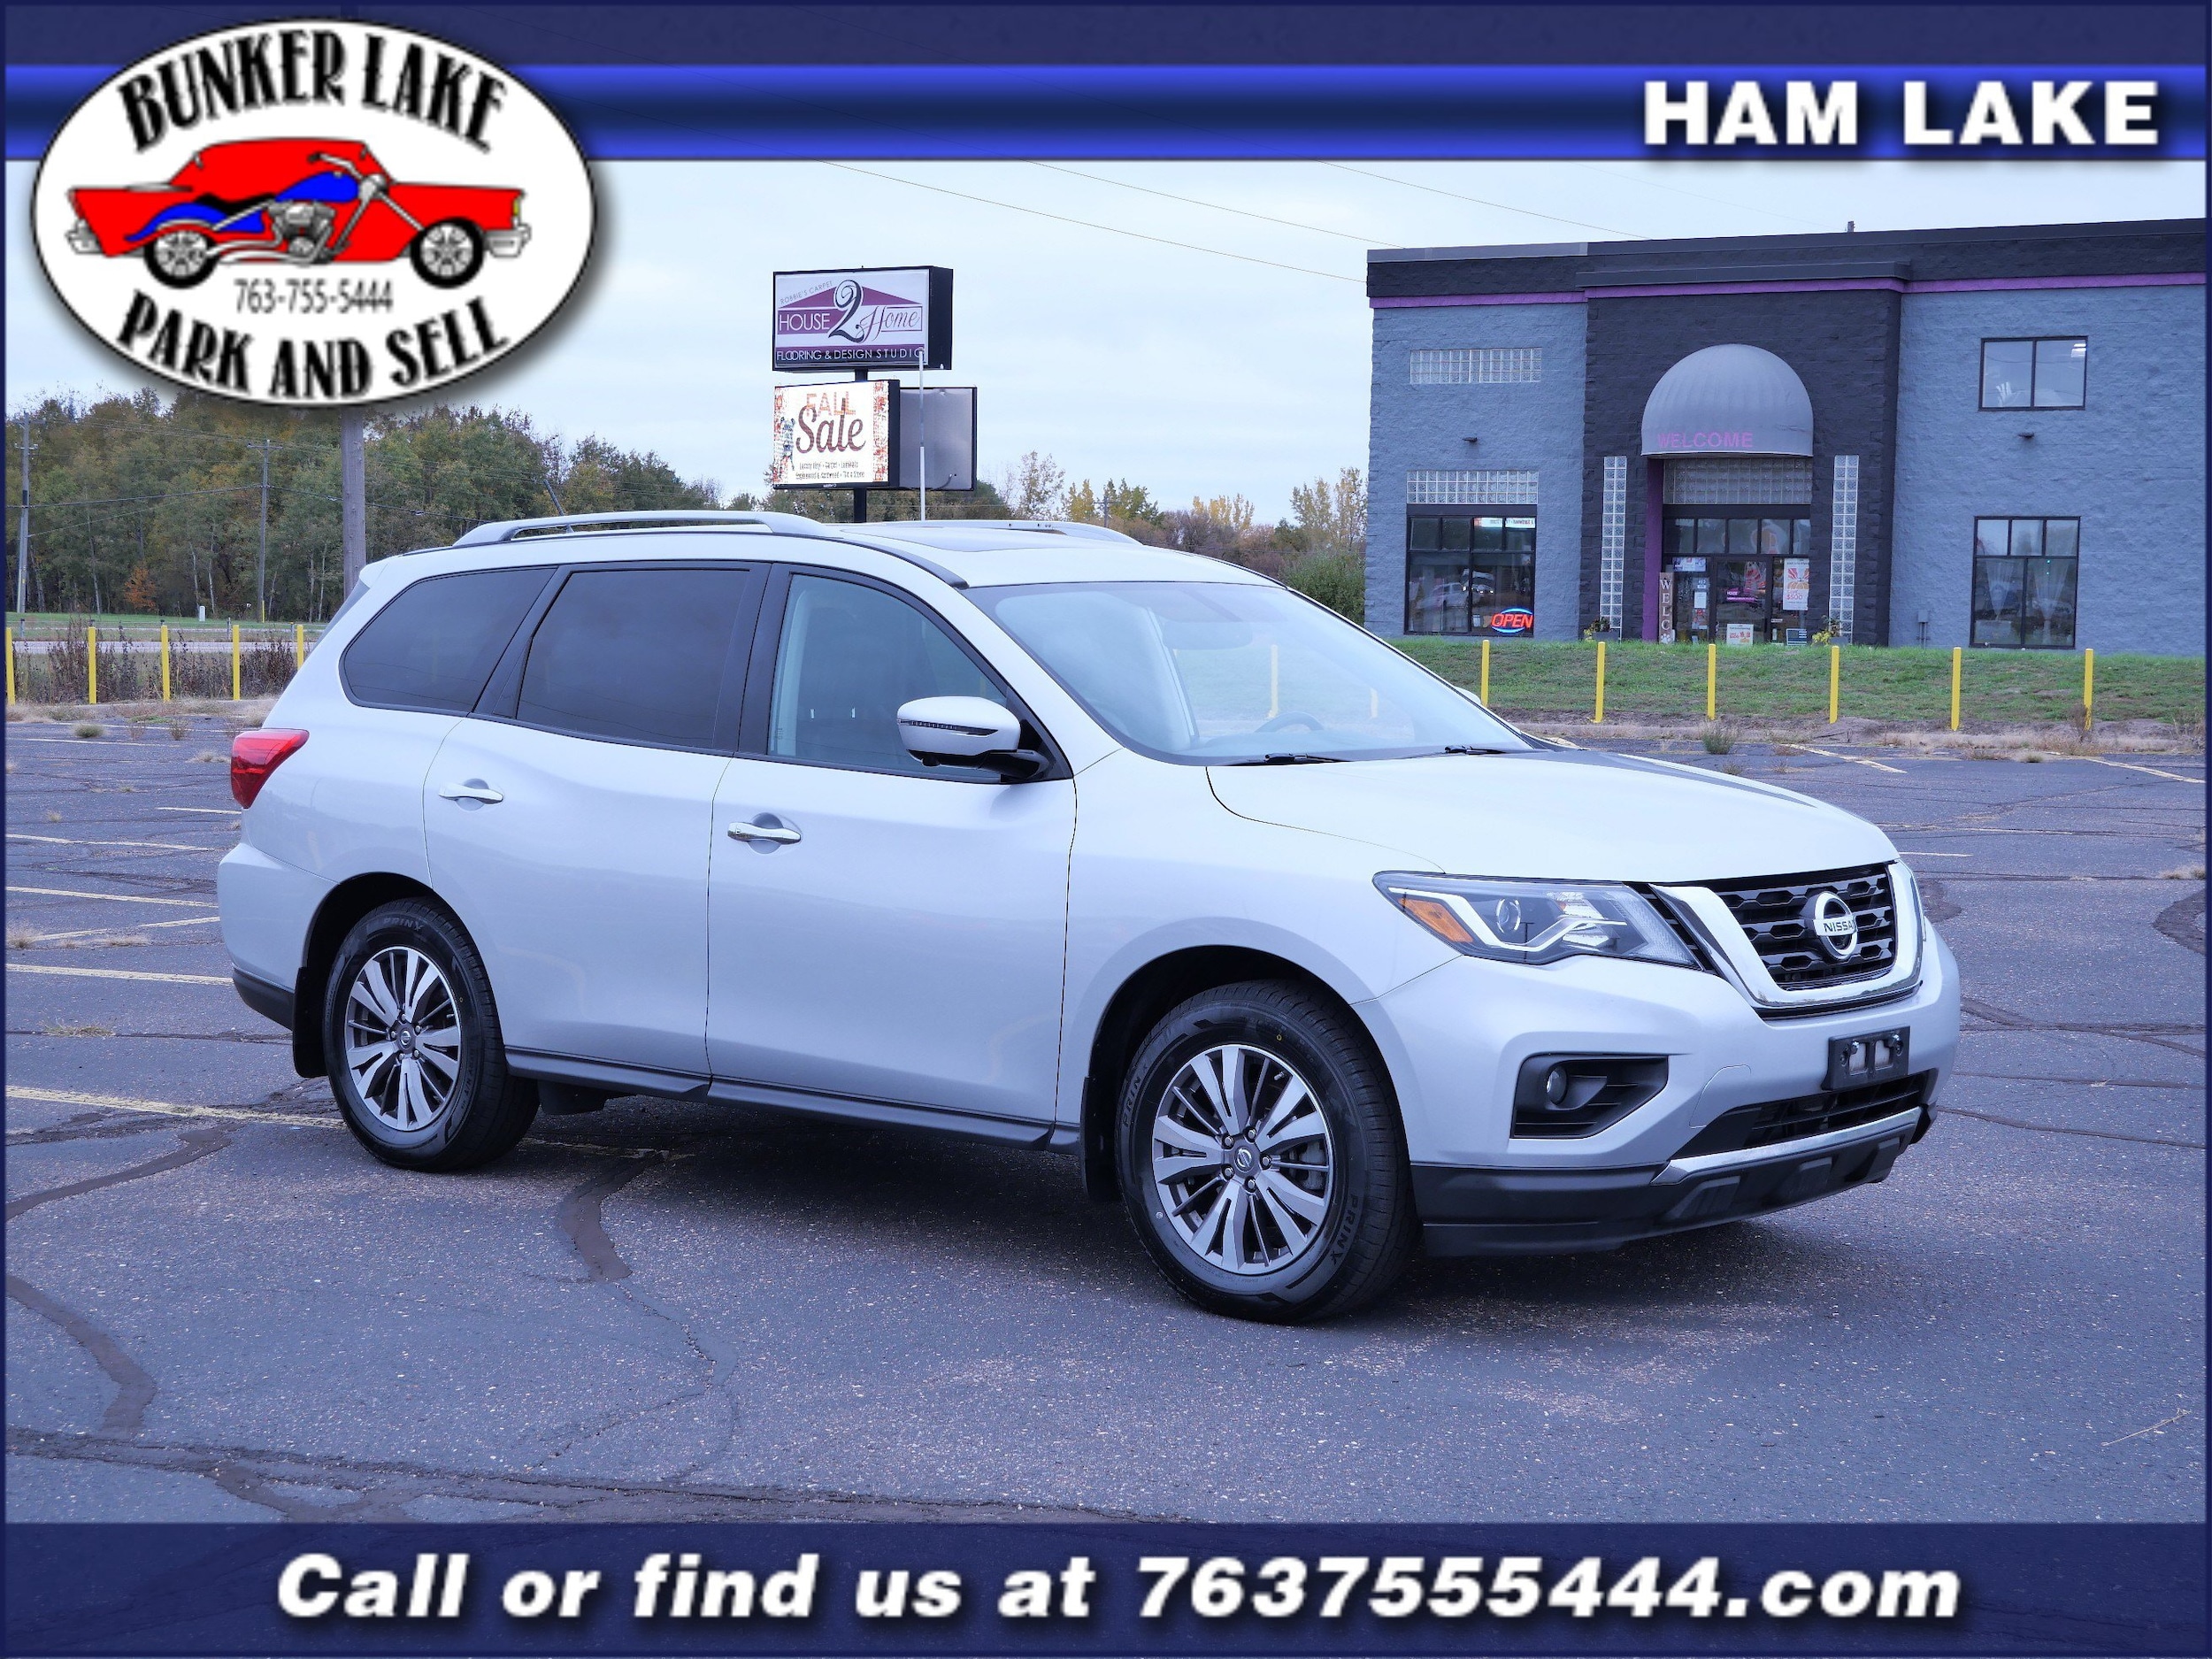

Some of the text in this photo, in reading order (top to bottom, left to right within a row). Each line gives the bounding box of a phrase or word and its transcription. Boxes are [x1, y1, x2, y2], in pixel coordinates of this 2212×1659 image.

[780, 289, 808, 305] ROBBIE'S
[779, 279, 921, 344] HOUSE 2 Home
[776, 347, 925, 361] FLOORING & DESIGN STUDIO
[806, 390, 856, 417] FALL
[795, 397, 867, 454] Sale
[1657, 431, 1754, 449] WELCOME
[1491, 612, 1533, 628] OPEN
